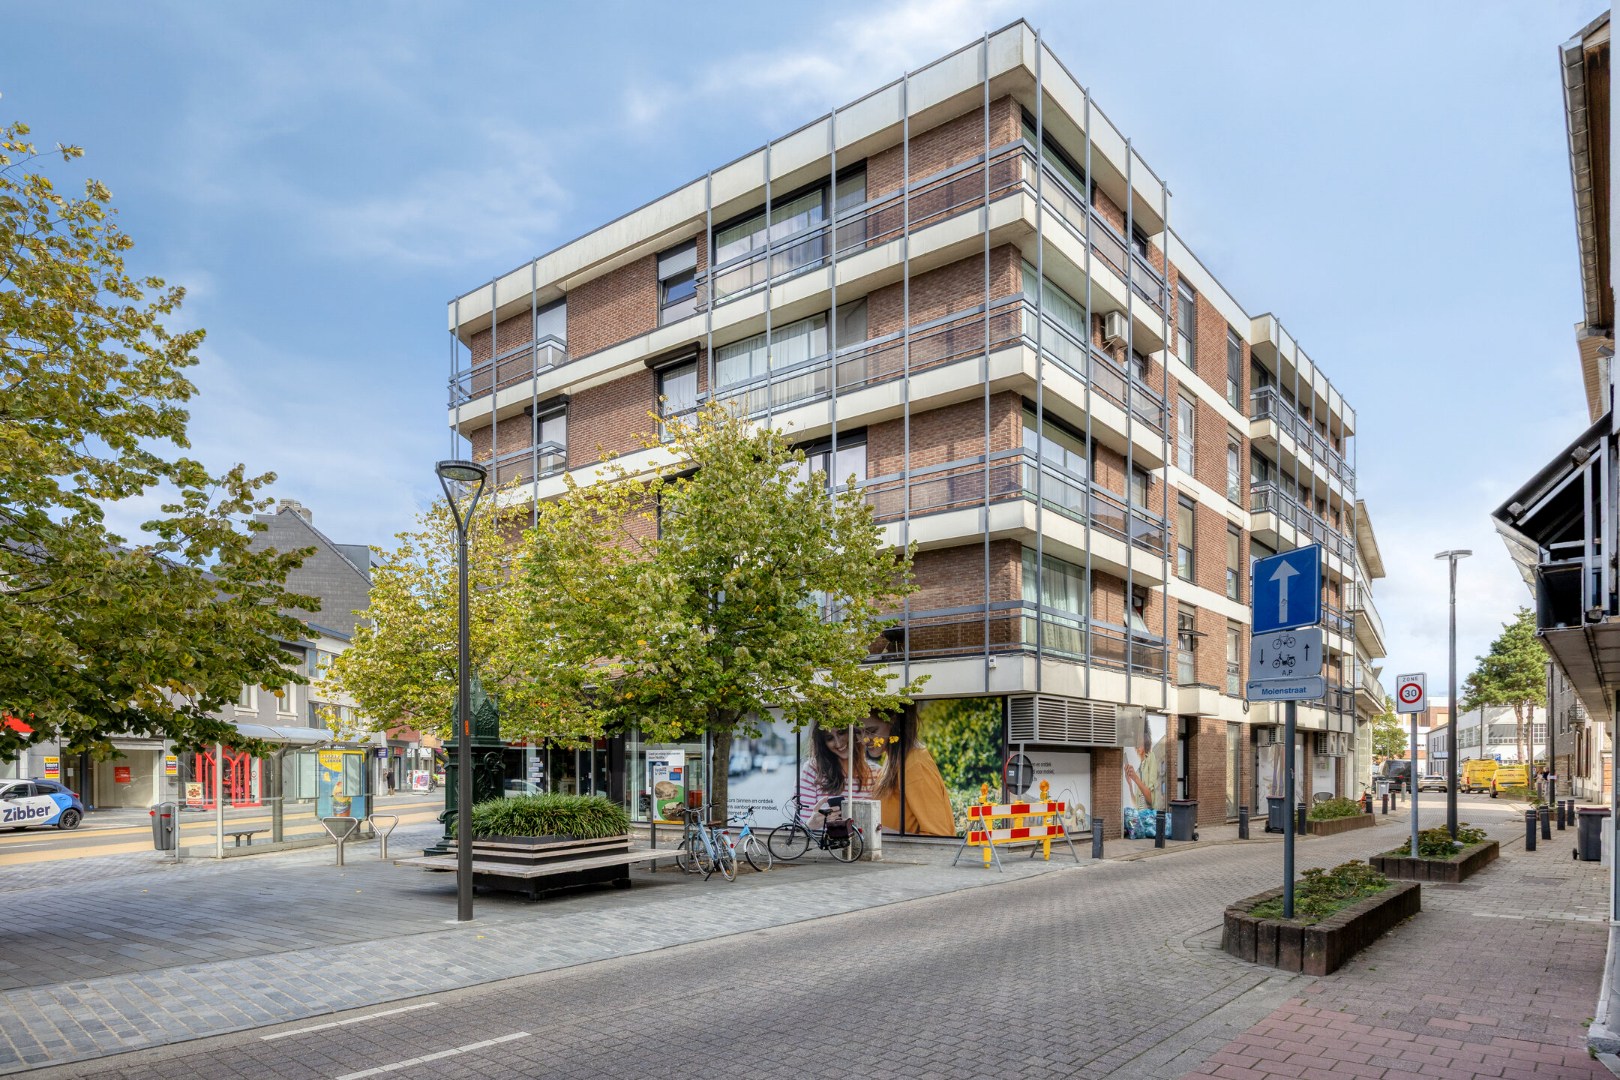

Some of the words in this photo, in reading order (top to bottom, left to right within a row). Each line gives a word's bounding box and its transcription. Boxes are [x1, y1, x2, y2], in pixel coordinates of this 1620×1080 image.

[1261, 687, 1307, 695] Molenstraat
[1404, 689, 1417, 698] 30
[3, 805, 51, 823] Zibber
